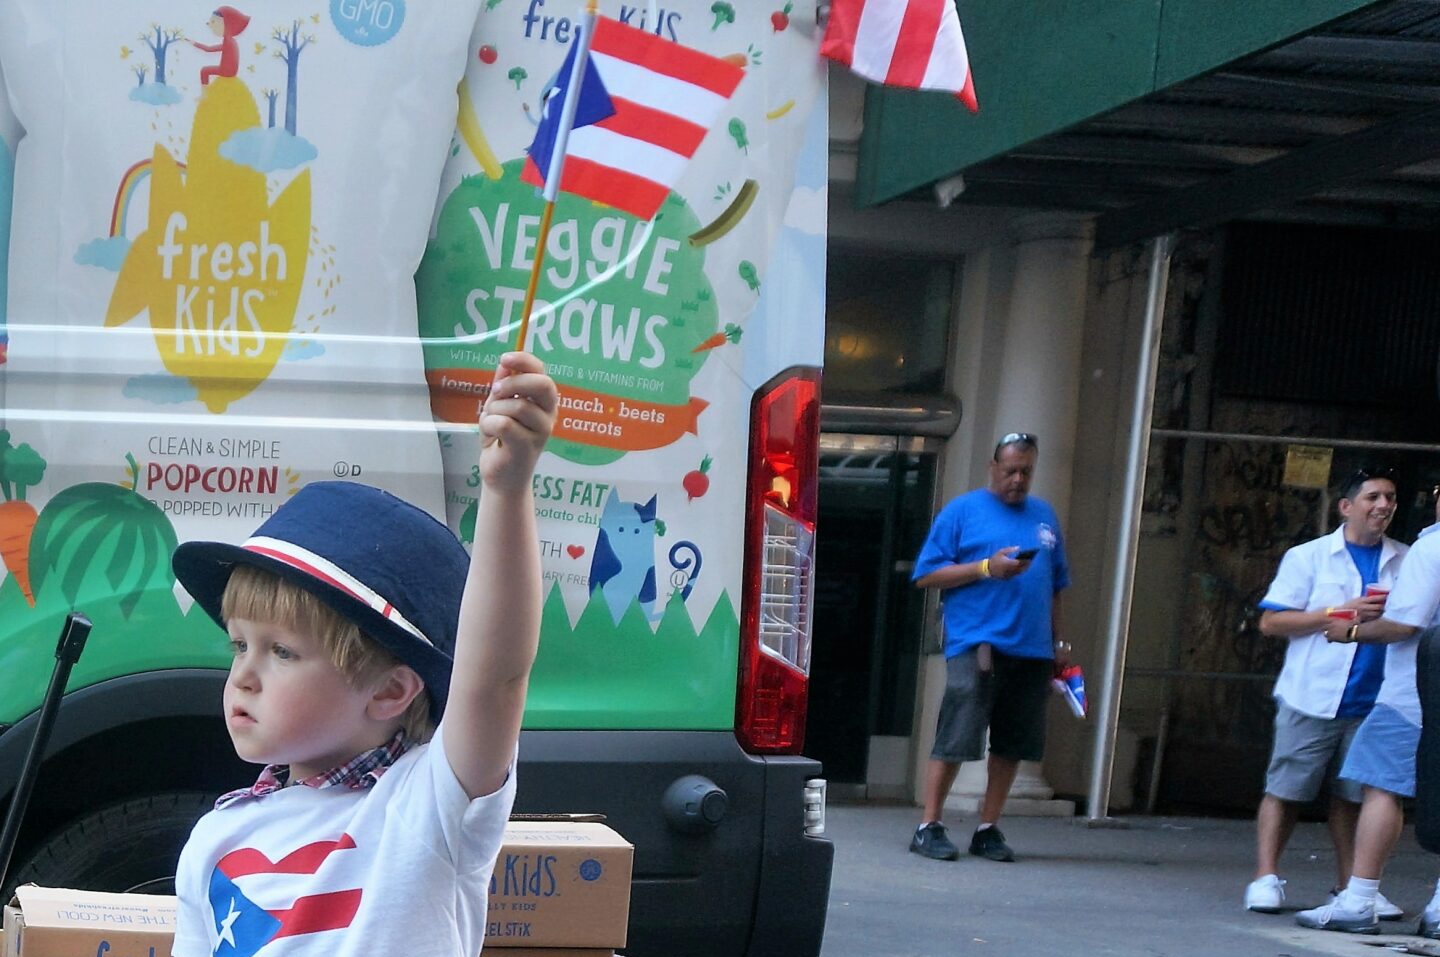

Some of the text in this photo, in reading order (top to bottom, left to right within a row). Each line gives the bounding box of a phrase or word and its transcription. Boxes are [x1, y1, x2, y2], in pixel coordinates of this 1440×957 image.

[340, 0, 394, 29] GMO
[523, 0, 570, 43] fre
[157, 211, 287, 281] fresh
[449, 349, 481, 363] WITH
[577, 367, 584, 379] &
[588, 369, 634, 387] VITAMINS
[636, 377, 665, 392] FROM
[441, 375, 665, 424] tomat inach beets
[563, 417, 622, 437] carrots
[148, 436, 281, 460] CLEAN & SIMPLE
[147, 462, 279, 494] POPCORN
[533, 473, 609, 507] ESS FAT
[163, 500, 223, 517] POPPED
[227, 502, 273, 518] WITH
[577, 511, 602, 529] chi
[540, 540, 563, 559] TH
[566, 573, 590, 587] FRE
[103, 912, 133, 925] NEW
